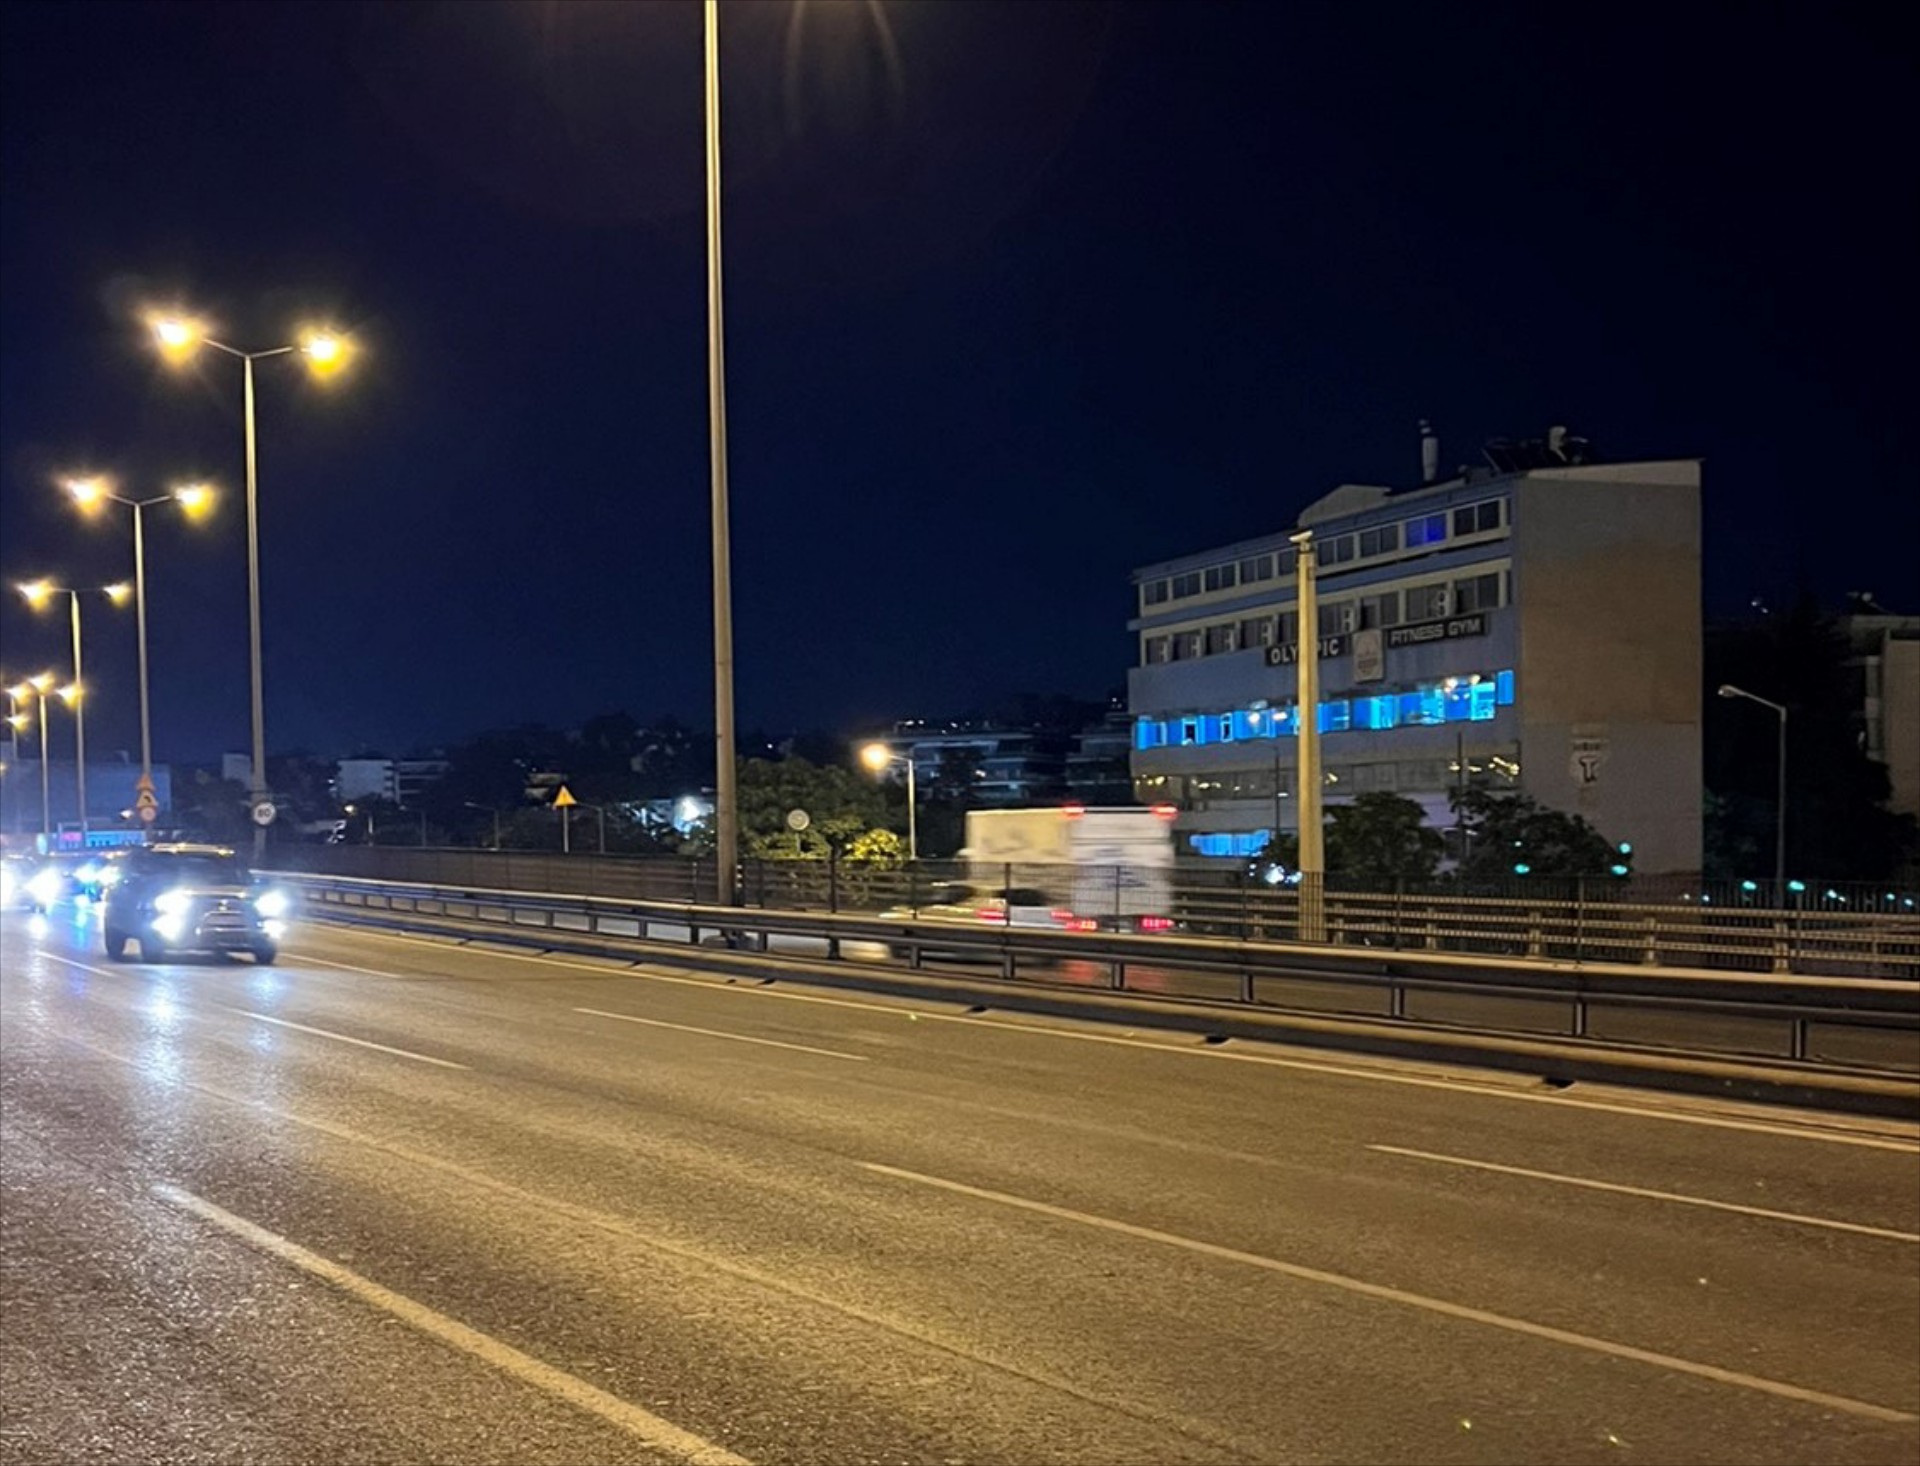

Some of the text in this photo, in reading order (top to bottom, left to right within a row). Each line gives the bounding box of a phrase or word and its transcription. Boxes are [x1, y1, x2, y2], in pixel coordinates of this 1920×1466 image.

[1390, 617, 1481, 645] FITNESS GYM
[1271, 638, 1339, 664] OLYIC
